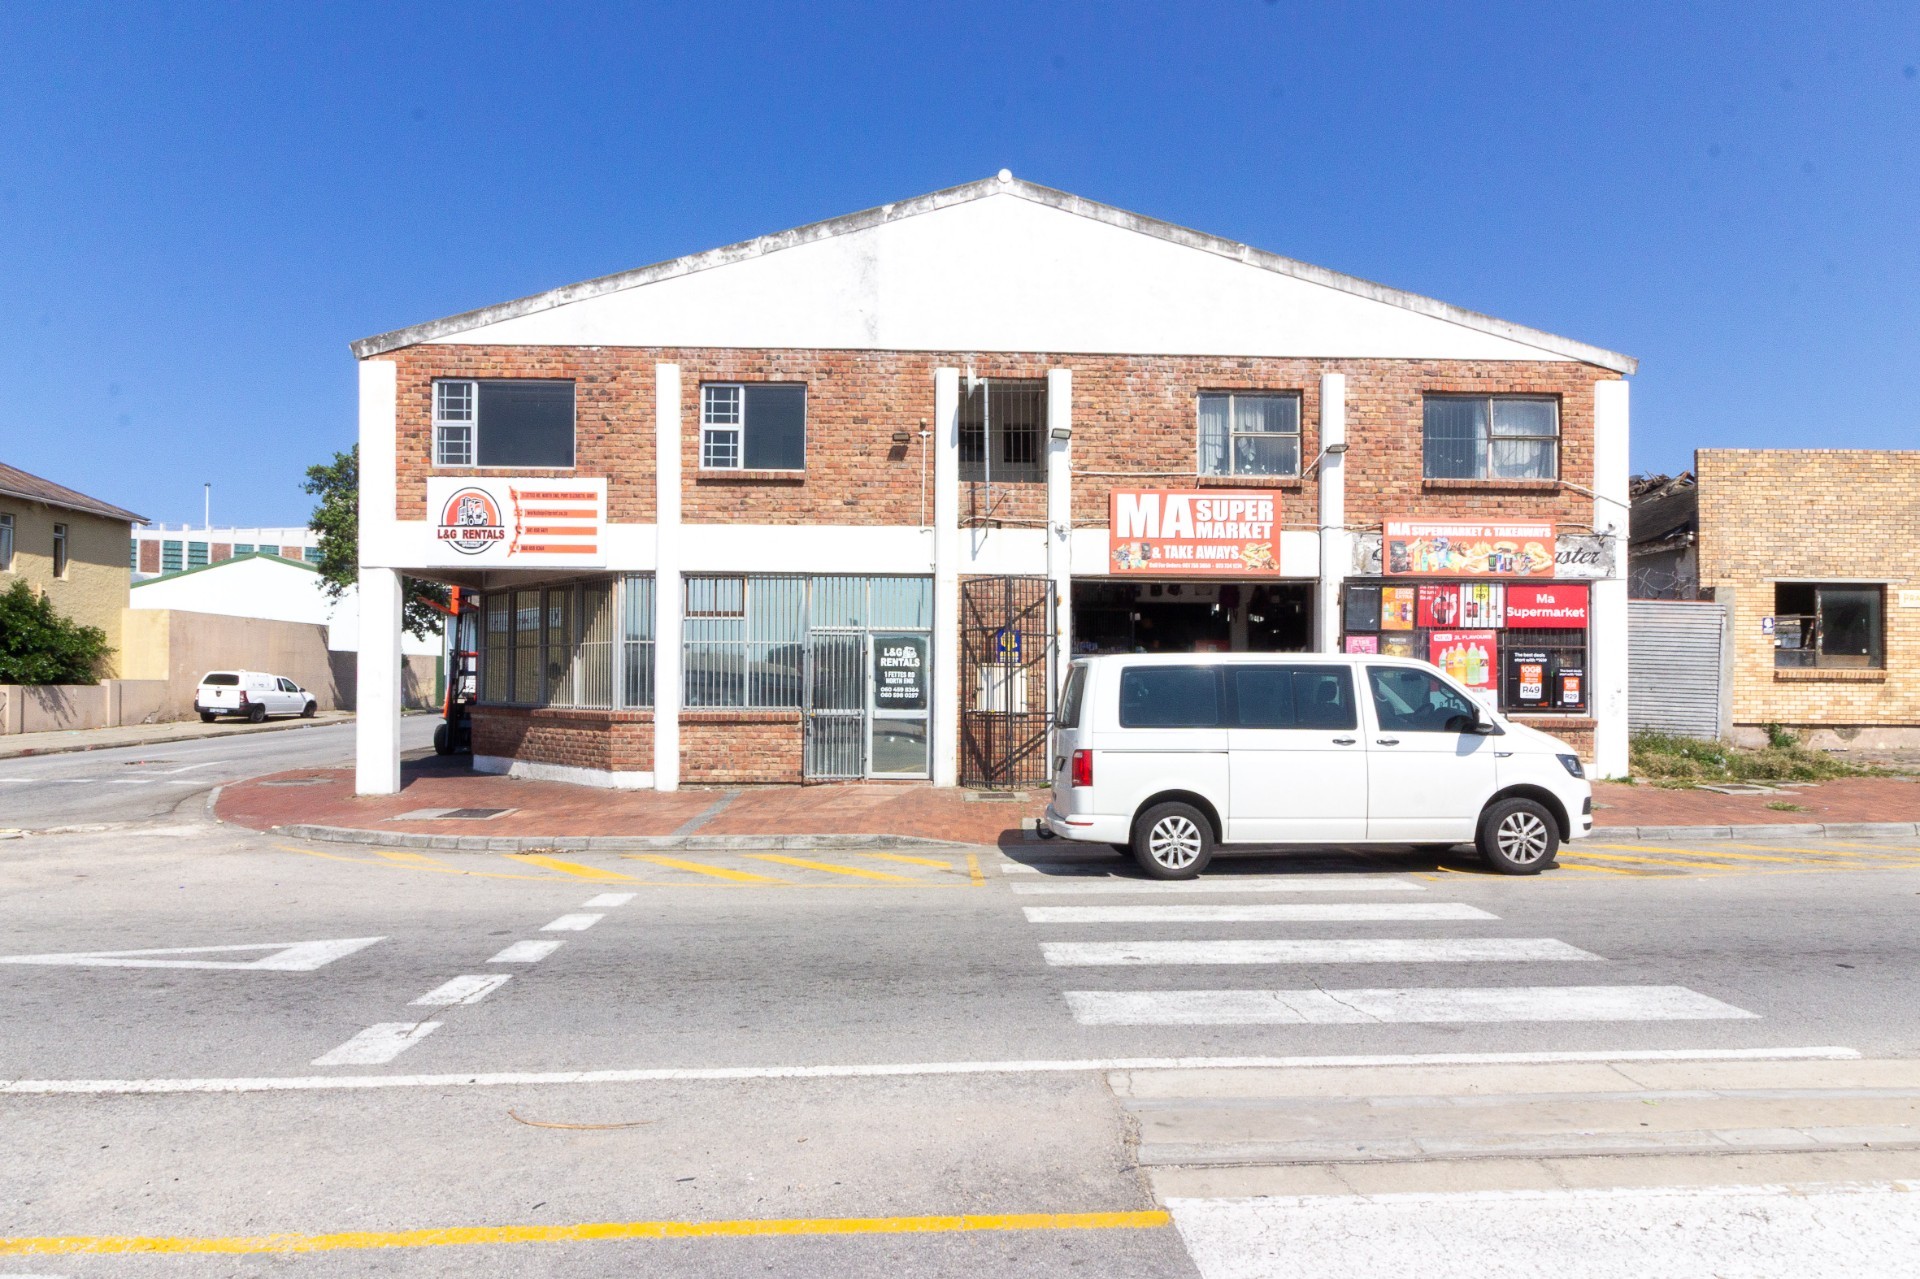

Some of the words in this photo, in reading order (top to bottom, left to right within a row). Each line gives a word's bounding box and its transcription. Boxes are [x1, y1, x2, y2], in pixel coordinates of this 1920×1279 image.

[1116, 494, 1196, 538] MA
[1196, 500, 1274, 522] SUPER
[438, 529, 457, 539] L&G
[462, 529, 505, 539] RENTALS
[1196, 522, 1274, 539] MARKET
[1388, 522, 1410, 536] MA
[1412, 526, 1482, 536] SUPERMARKET
[1484, 528, 1492, 537] &
[1494, 527, 1551, 537] TAKEAWAYS
[1152, 546, 1161, 559] &
[1163, 545, 1193, 559] TAKE
[1195, 545, 1239, 559] AWAYS
[1536, 594, 1555, 604] Ma
[1507, 607, 1585, 618] Supermarket
[884, 648, 902, 657] L&G
[881, 658, 920, 667] RENTALS
[1523, 686, 1540, 694] R49
